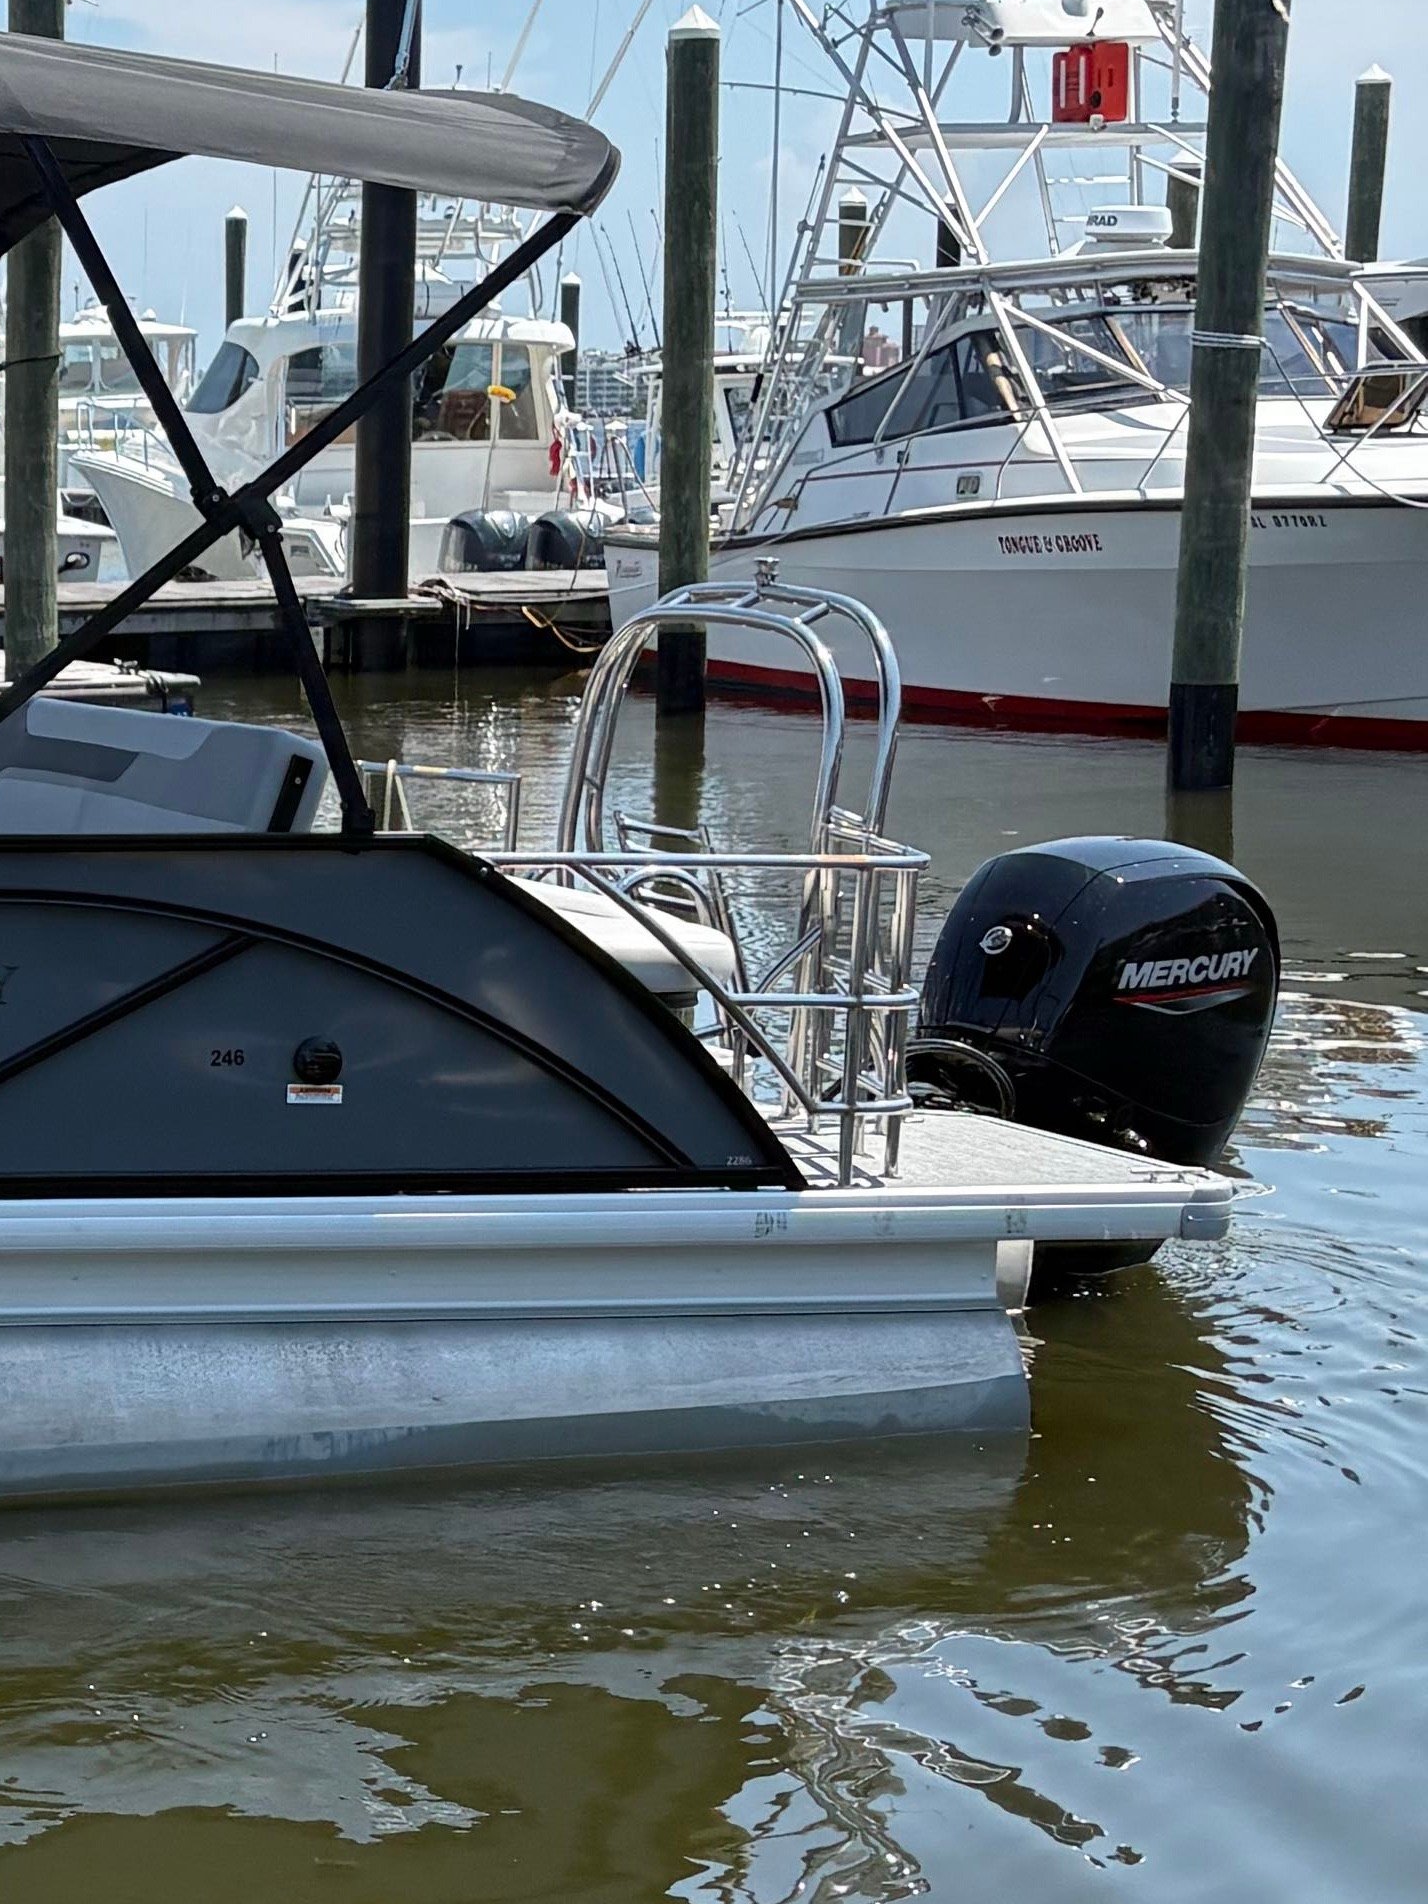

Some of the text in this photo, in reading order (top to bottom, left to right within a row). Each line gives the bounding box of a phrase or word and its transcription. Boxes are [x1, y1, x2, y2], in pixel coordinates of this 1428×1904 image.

[998, 536, 1042, 554] TONGUE
[1055, 534, 1102, 553] GROOVE
[1117, 947, 1259, 990] MERCURY
[210, 1049, 245, 1067] 246
